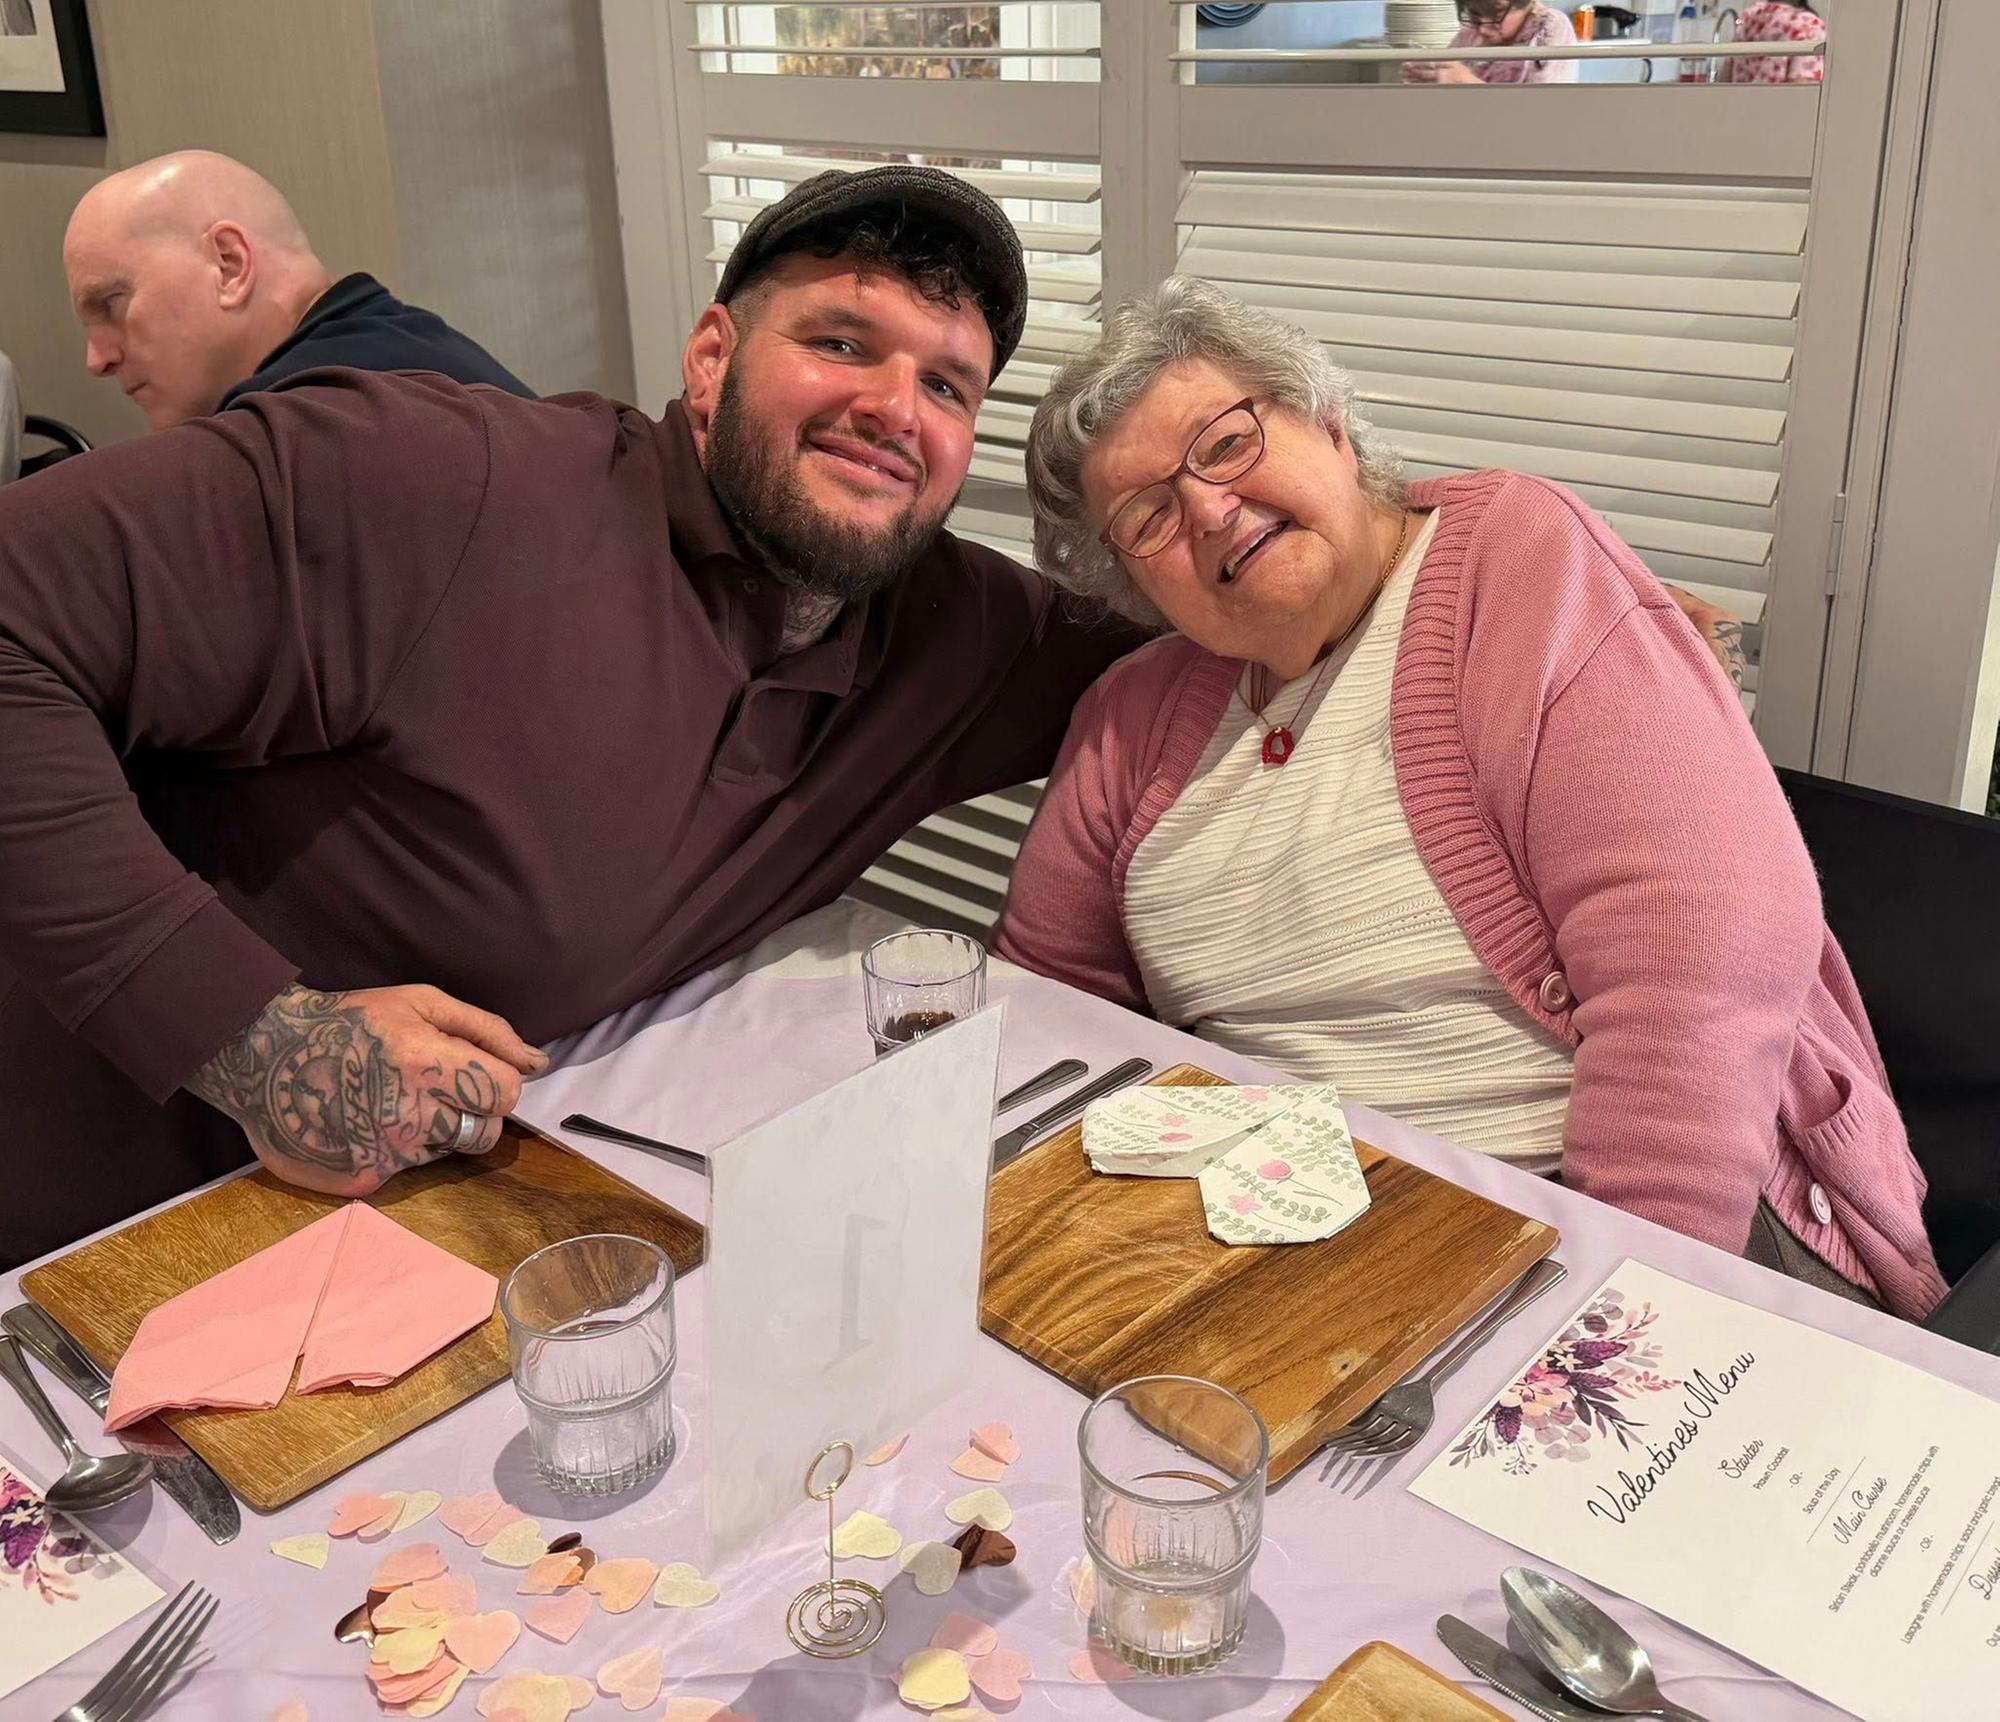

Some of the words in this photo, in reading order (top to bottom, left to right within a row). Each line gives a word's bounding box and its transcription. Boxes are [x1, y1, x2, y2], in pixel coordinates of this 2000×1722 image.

[1587, 1419, 1699, 1524] Valentines
[1682, 1352, 1755, 1418] Menu
[1717, 1439, 1764, 1479] Starter
[1753, 1470, 1773, 1490] Prawn
[1766, 1446, 1790, 1472] Cocktail
[1820, 1480, 1831, 1491] the
[1825, 1467, 1841, 1481] Day
[1802, 1497, 1819, 1514] Soup
[1814, 1489, 1824, 1499] of
[1978, 1494, 1992, 1515] garlic
[1833, 1511, 1867, 1545] Main
[1852, 1476, 1887, 1511] Course
[1970, 1510, 1982, 1526] and
[1828, 1592, 1847, 1613] Sirloin
[1855, 1539, 1880, 1575] portobello
[1894, 1472, 1921, 1509] homemade
[1917, 1457, 1932, 1474] chips
[1928, 1445, 1940, 1458] with
[1870, 1554, 1889, 1578] dianne
[1885, 1534, 1900, 1555] sauce
[1896, 1525, 1904, 1535] or
[1900, 1504, 1919, 1527] cheese
[1915, 1485, 1930, 1505] sauce
[1960, 1523, 1975, 1544] salad
[1926, 1560, 1952, 1601] homemade
[1920, 1598, 1933, 1615] with
[1900, 1613, 1924, 1645] Lasagne
